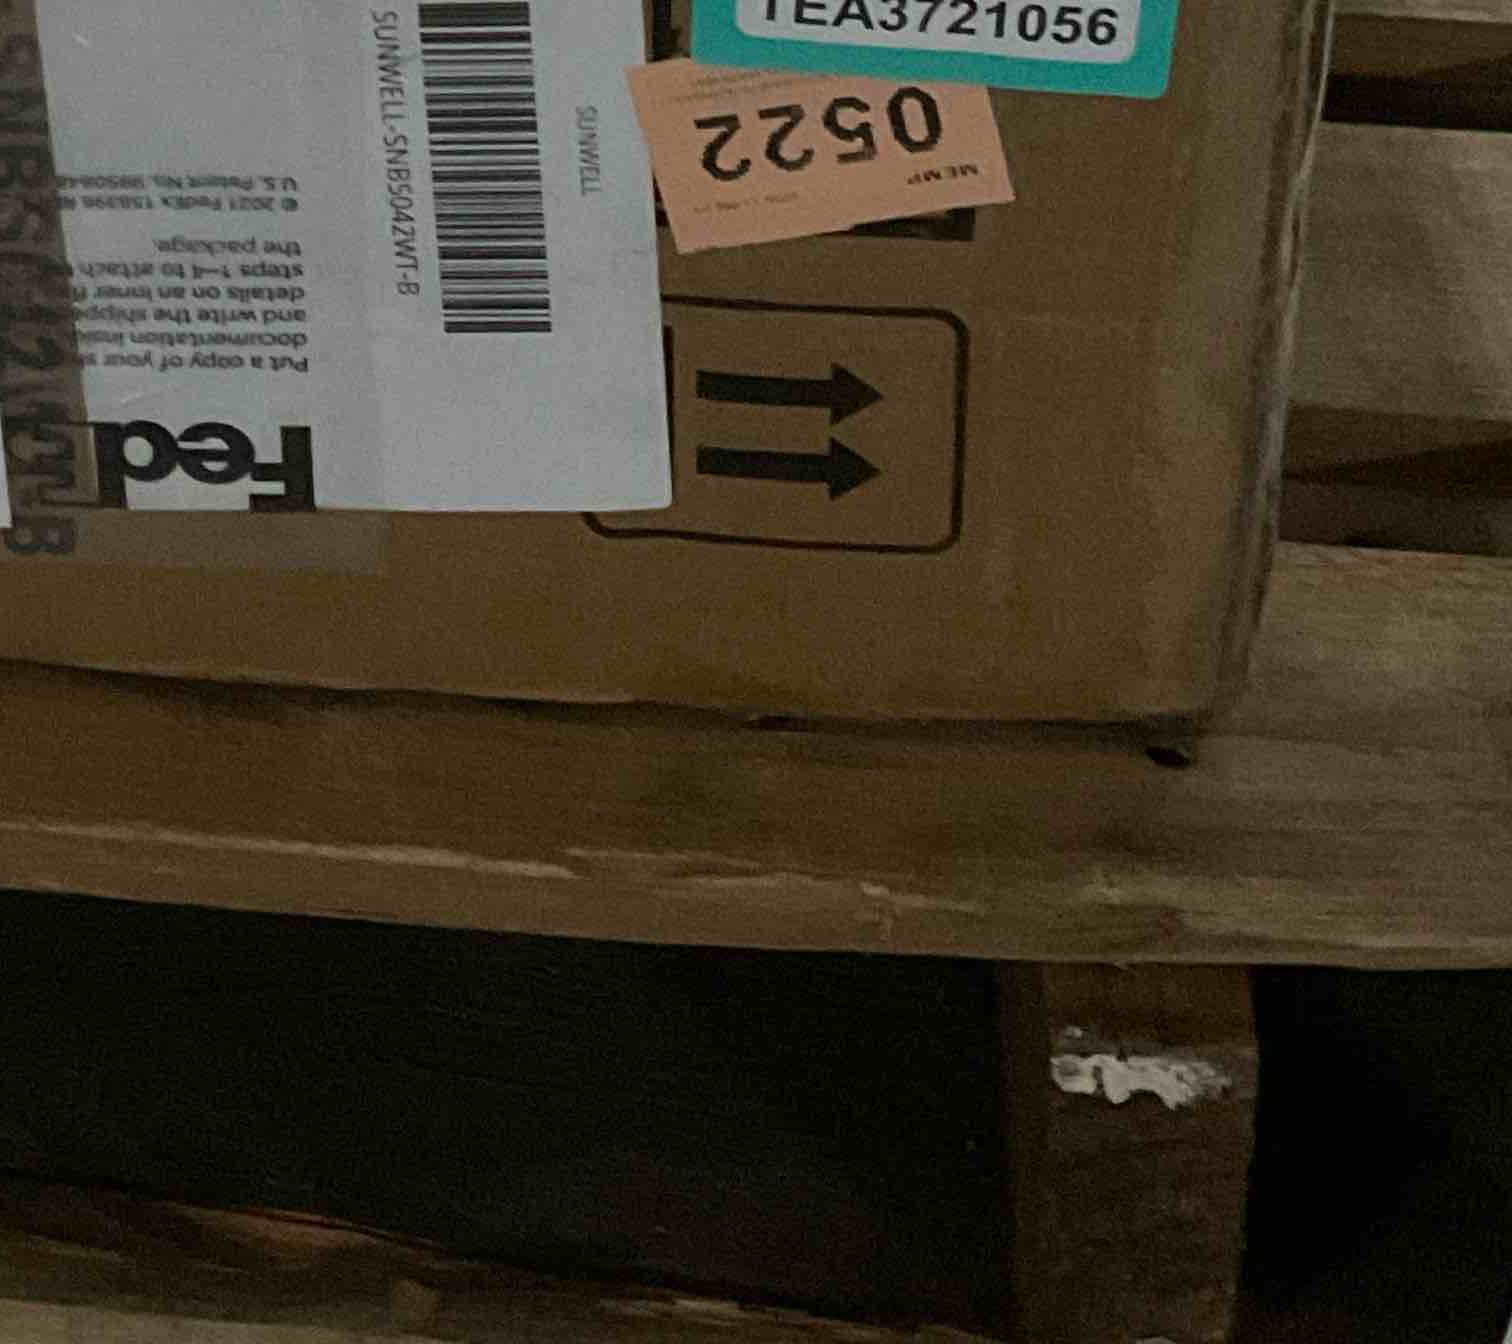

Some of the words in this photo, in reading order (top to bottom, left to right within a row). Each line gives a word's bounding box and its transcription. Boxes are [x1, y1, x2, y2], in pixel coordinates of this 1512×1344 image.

[693, 85, 944, 182] 0522
[371, 8, 422, 296] SUNWELL-SNBS042WT-B
[575, 104, 602, 197] SUNWELL
[262, 240, 303, 258] the
[77, 262, 154, 280] attach
[160, 262, 185, 279] to
[239, 259, 305, 279] steps
[92, 285, 153, 302] inner
[156, 285, 186, 301] an
[191, 285, 221, 301] on
[226, 285, 306, 304] details
[152, 308, 190, 325] the
[196, 308, 258, 326] write
[263, 308, 307, 325] and
[129, 331, 308, 351] documentation
[103, 351, 154, 368] your
[158, 355, 183, 374] of
[190, 351, 244, 370] copy
[250, 356, 263, 370] a
[268, 355, 309, 374] Put
[3, 420, 315, 512] Fed
